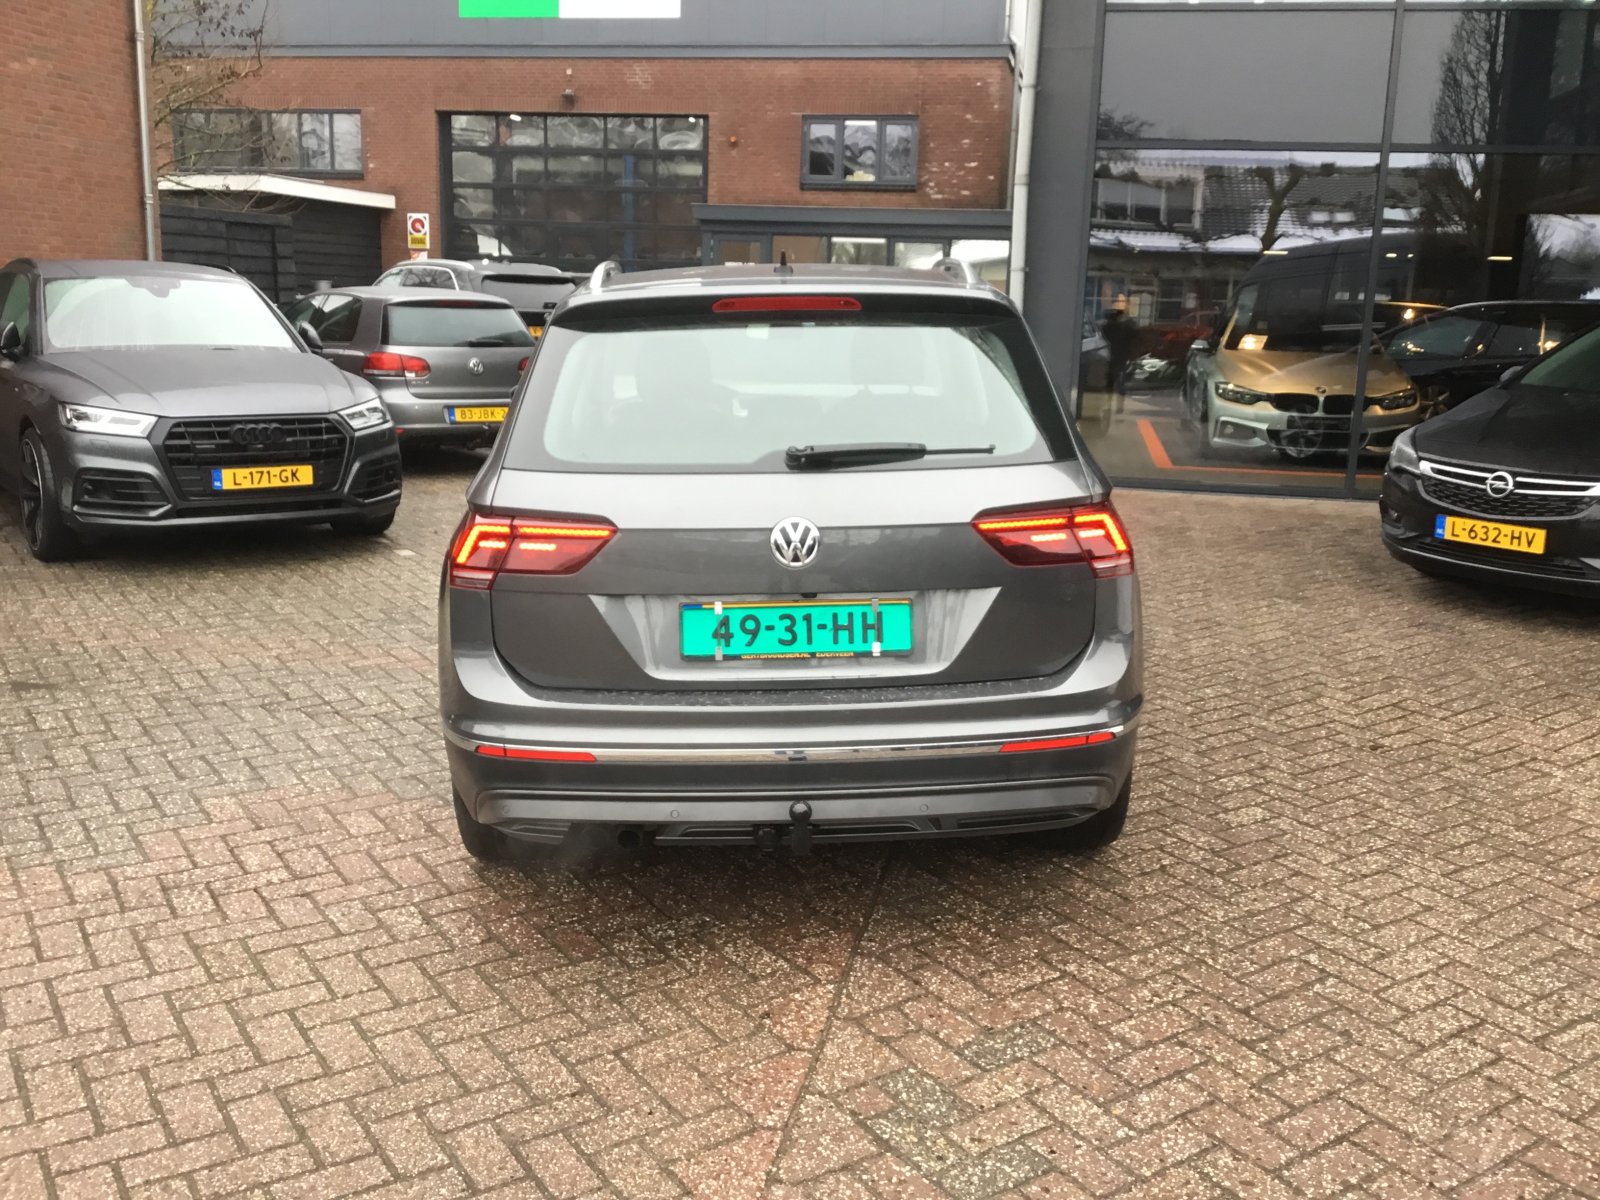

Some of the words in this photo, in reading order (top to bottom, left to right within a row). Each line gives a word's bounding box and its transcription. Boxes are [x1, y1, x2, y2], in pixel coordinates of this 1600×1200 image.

[232, 468, 301, 486] L-171-GK
[1450, 520, 1537, 549] L-632-HV
[711, 610, 884, 648] 49-31-HH
